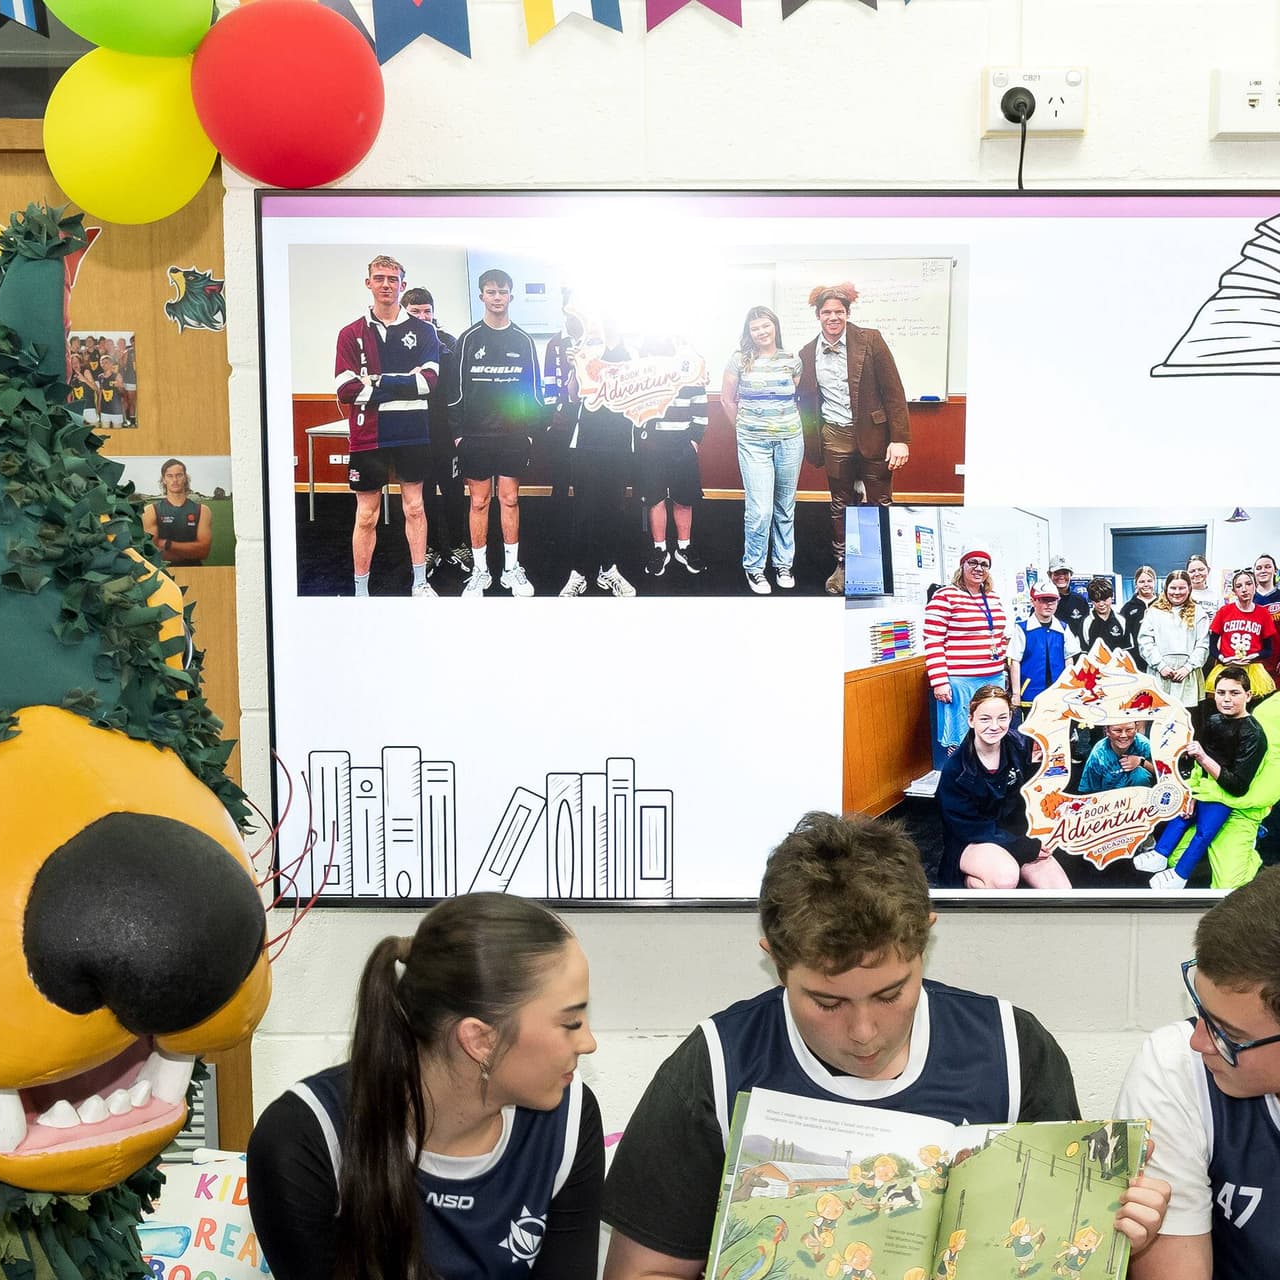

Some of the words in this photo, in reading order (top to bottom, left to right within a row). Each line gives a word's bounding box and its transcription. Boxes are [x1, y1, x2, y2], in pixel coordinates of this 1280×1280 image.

[470, 365, 523, 374] MICHELIN
[589, 371, 680, 406] Adventure
[1223, 620, 1262, 636] CHICAGO
[1084, 804, 1111, 819] BOOK
[1045, 804, 1160, 847] Adventure
[425, 1191, 475, 1210] NSD
[1216, 1181, 1264, 1230] 47
